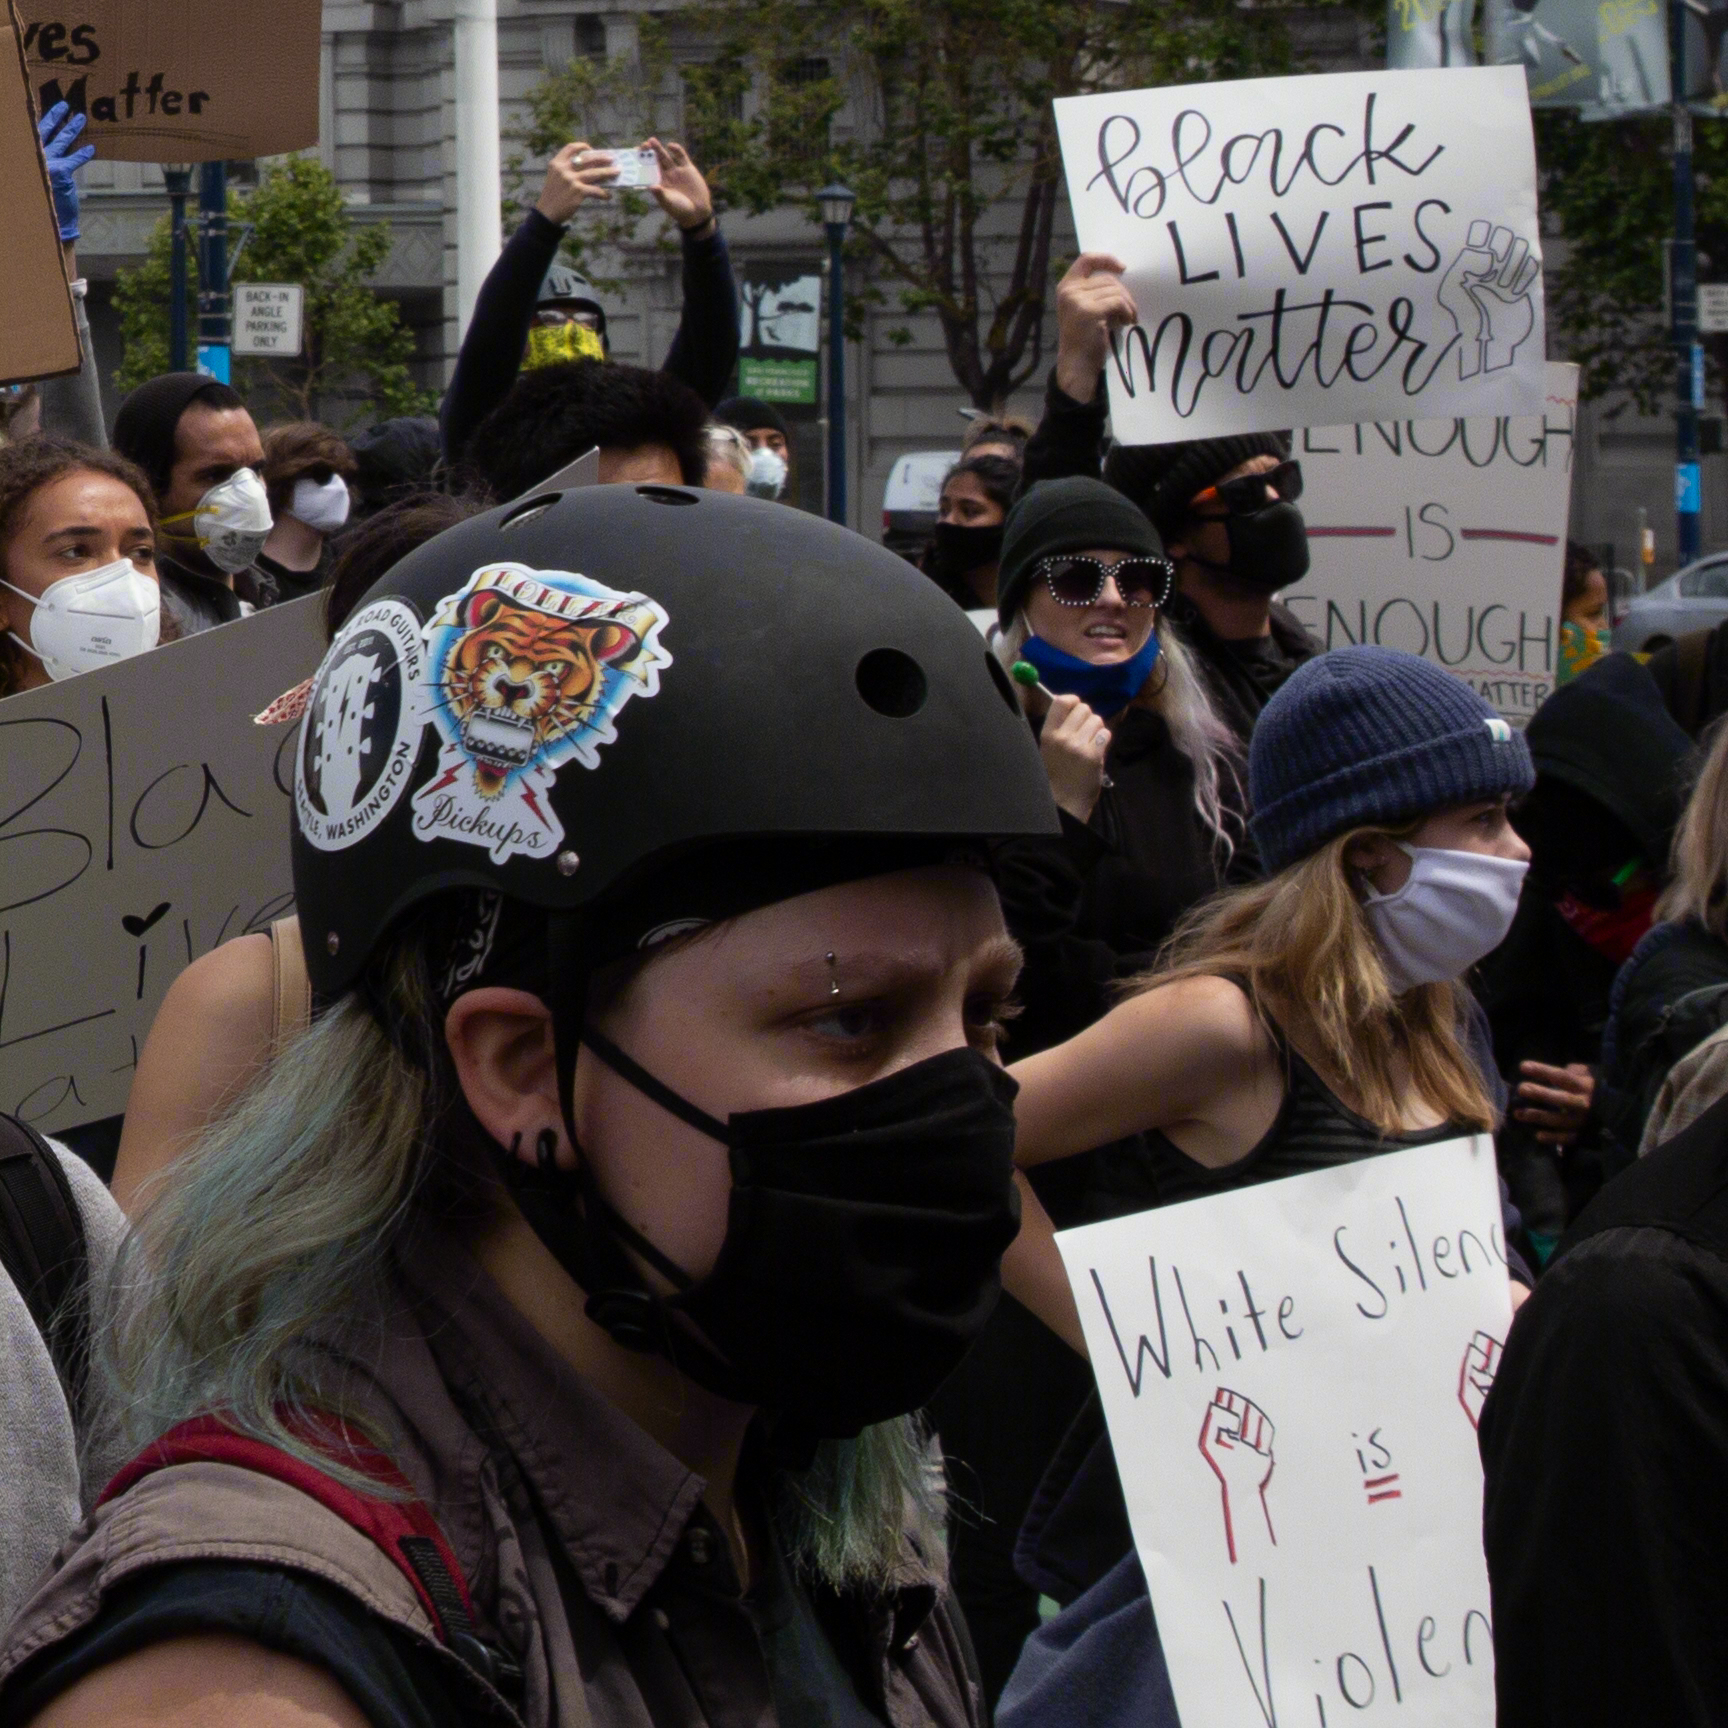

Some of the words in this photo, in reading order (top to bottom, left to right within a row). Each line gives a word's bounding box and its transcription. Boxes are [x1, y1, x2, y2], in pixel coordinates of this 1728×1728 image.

[38, 71, 211, 122] Matter
[1085, 92, 1446, 219] black
[1166, 198, 1453, 286] LIVES
[245, 290, 289, 303] BACK-IN
[250, 305, 283, 318] ANGLE
[245, 320, 288, 334] PARKING
[252, 335, 280, 348] ONLY
[1405, 502, 1455, 562] IS
[390, 613, 421, 682] GUITARS
[325, 741, 412, 842] WASHINGTON
[416, 793, 549, 855] Pickups
[1088, 1255, 1305, 1399] White
[1351, 1427, 1394, 1475] is
